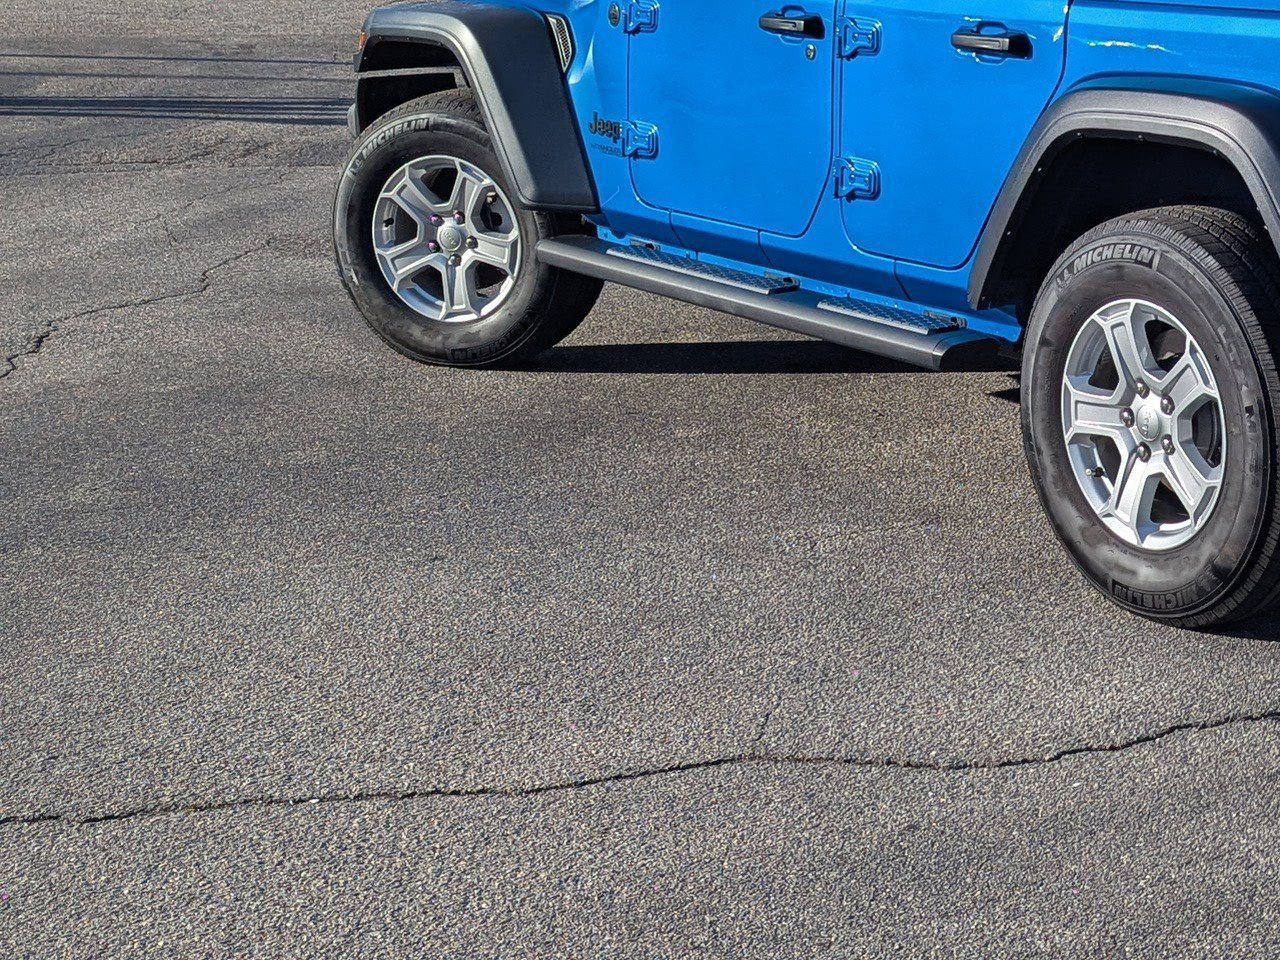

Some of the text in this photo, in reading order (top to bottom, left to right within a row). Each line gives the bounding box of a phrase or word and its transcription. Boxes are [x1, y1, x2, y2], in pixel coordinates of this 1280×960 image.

[362, 118, 429, 159] MICHELIN
[588, 110, 620, 144] Jeep
[1073, 244, 1155, 275] MICHELIN
[1114, 583, 1199, 609] MICHELIN
